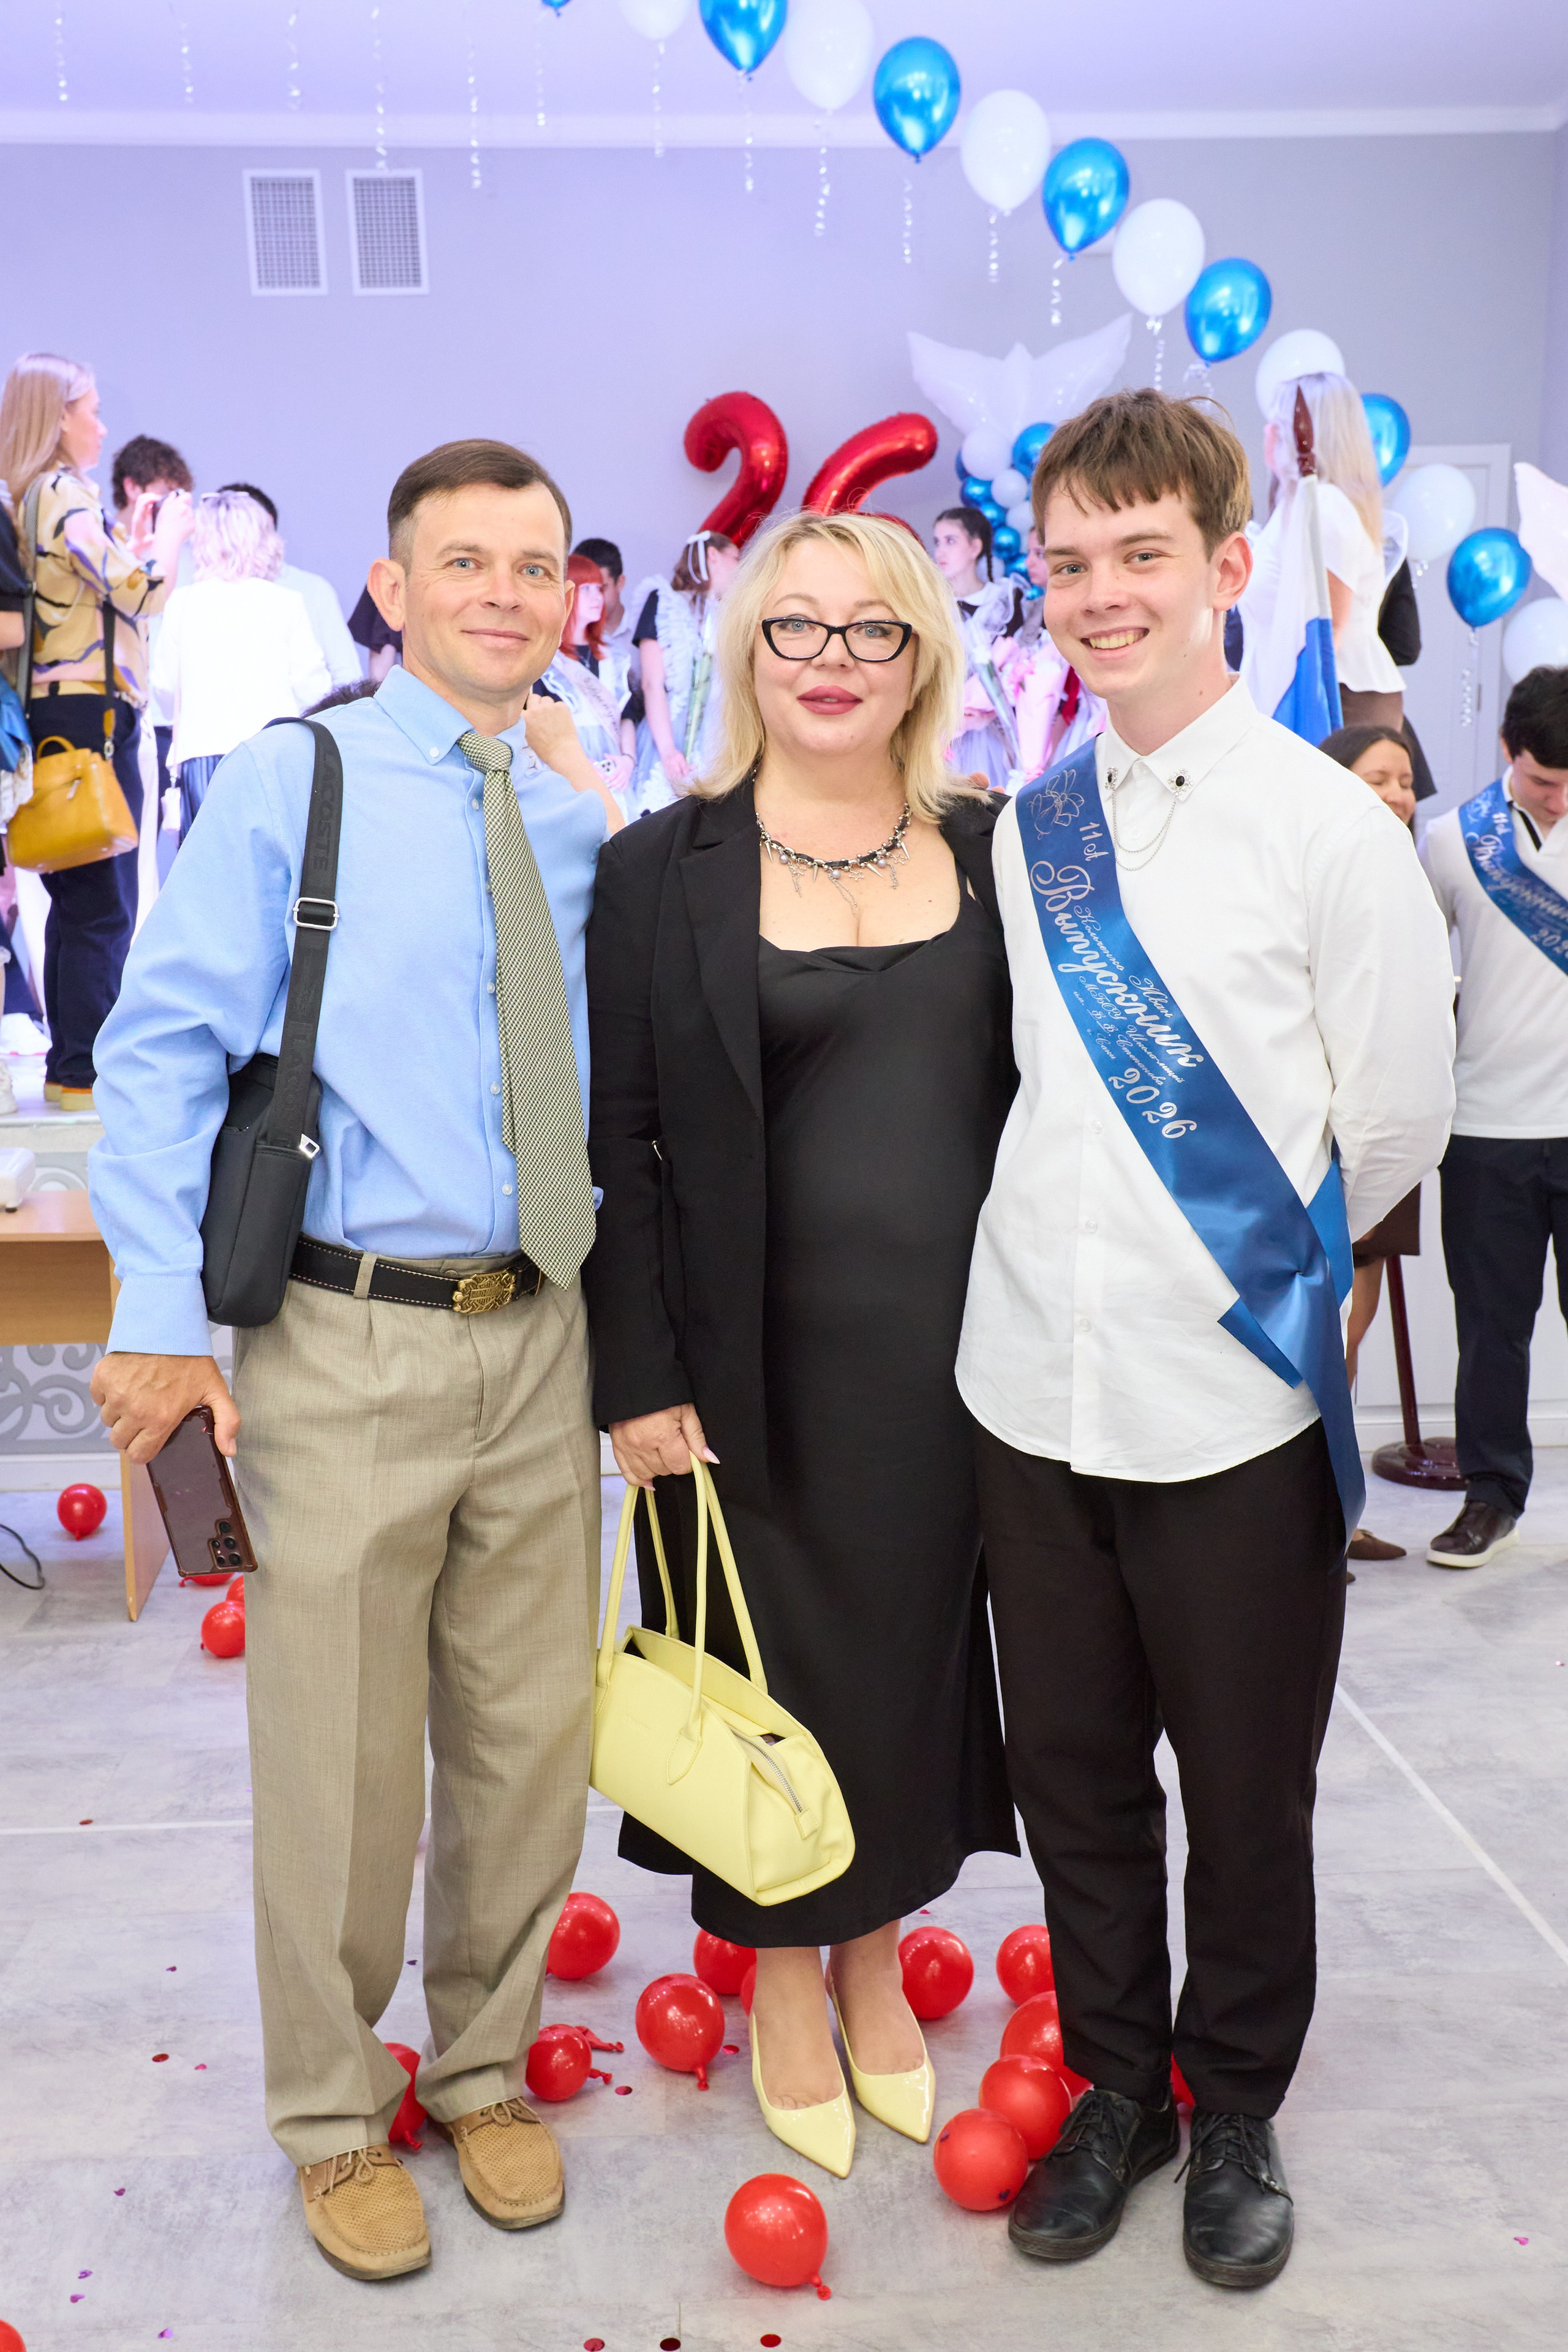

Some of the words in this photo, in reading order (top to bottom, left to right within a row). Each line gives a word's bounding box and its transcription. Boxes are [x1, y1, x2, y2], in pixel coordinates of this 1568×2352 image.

[313, 751, 336, 872] LACOSTE
[1030, 861, 1204, 1067] Выпускник
[1074, 905, 1125, 971] Кольченко
[1129, 975, 1173, 1018] Иван
[1531, 928, 1568, 959] 202
[1074, 991, 1085, 1006] им.
[1116, 1034, 1164, 1086] Степанова
[1079, 976, 1127, 1020] МБОУ
[1127, 1025, 1185, 1084] Школа-лицей
[1095, 1033, 1116, 1060] Саки
[1108, 1068, 1197, 1139] 2026
